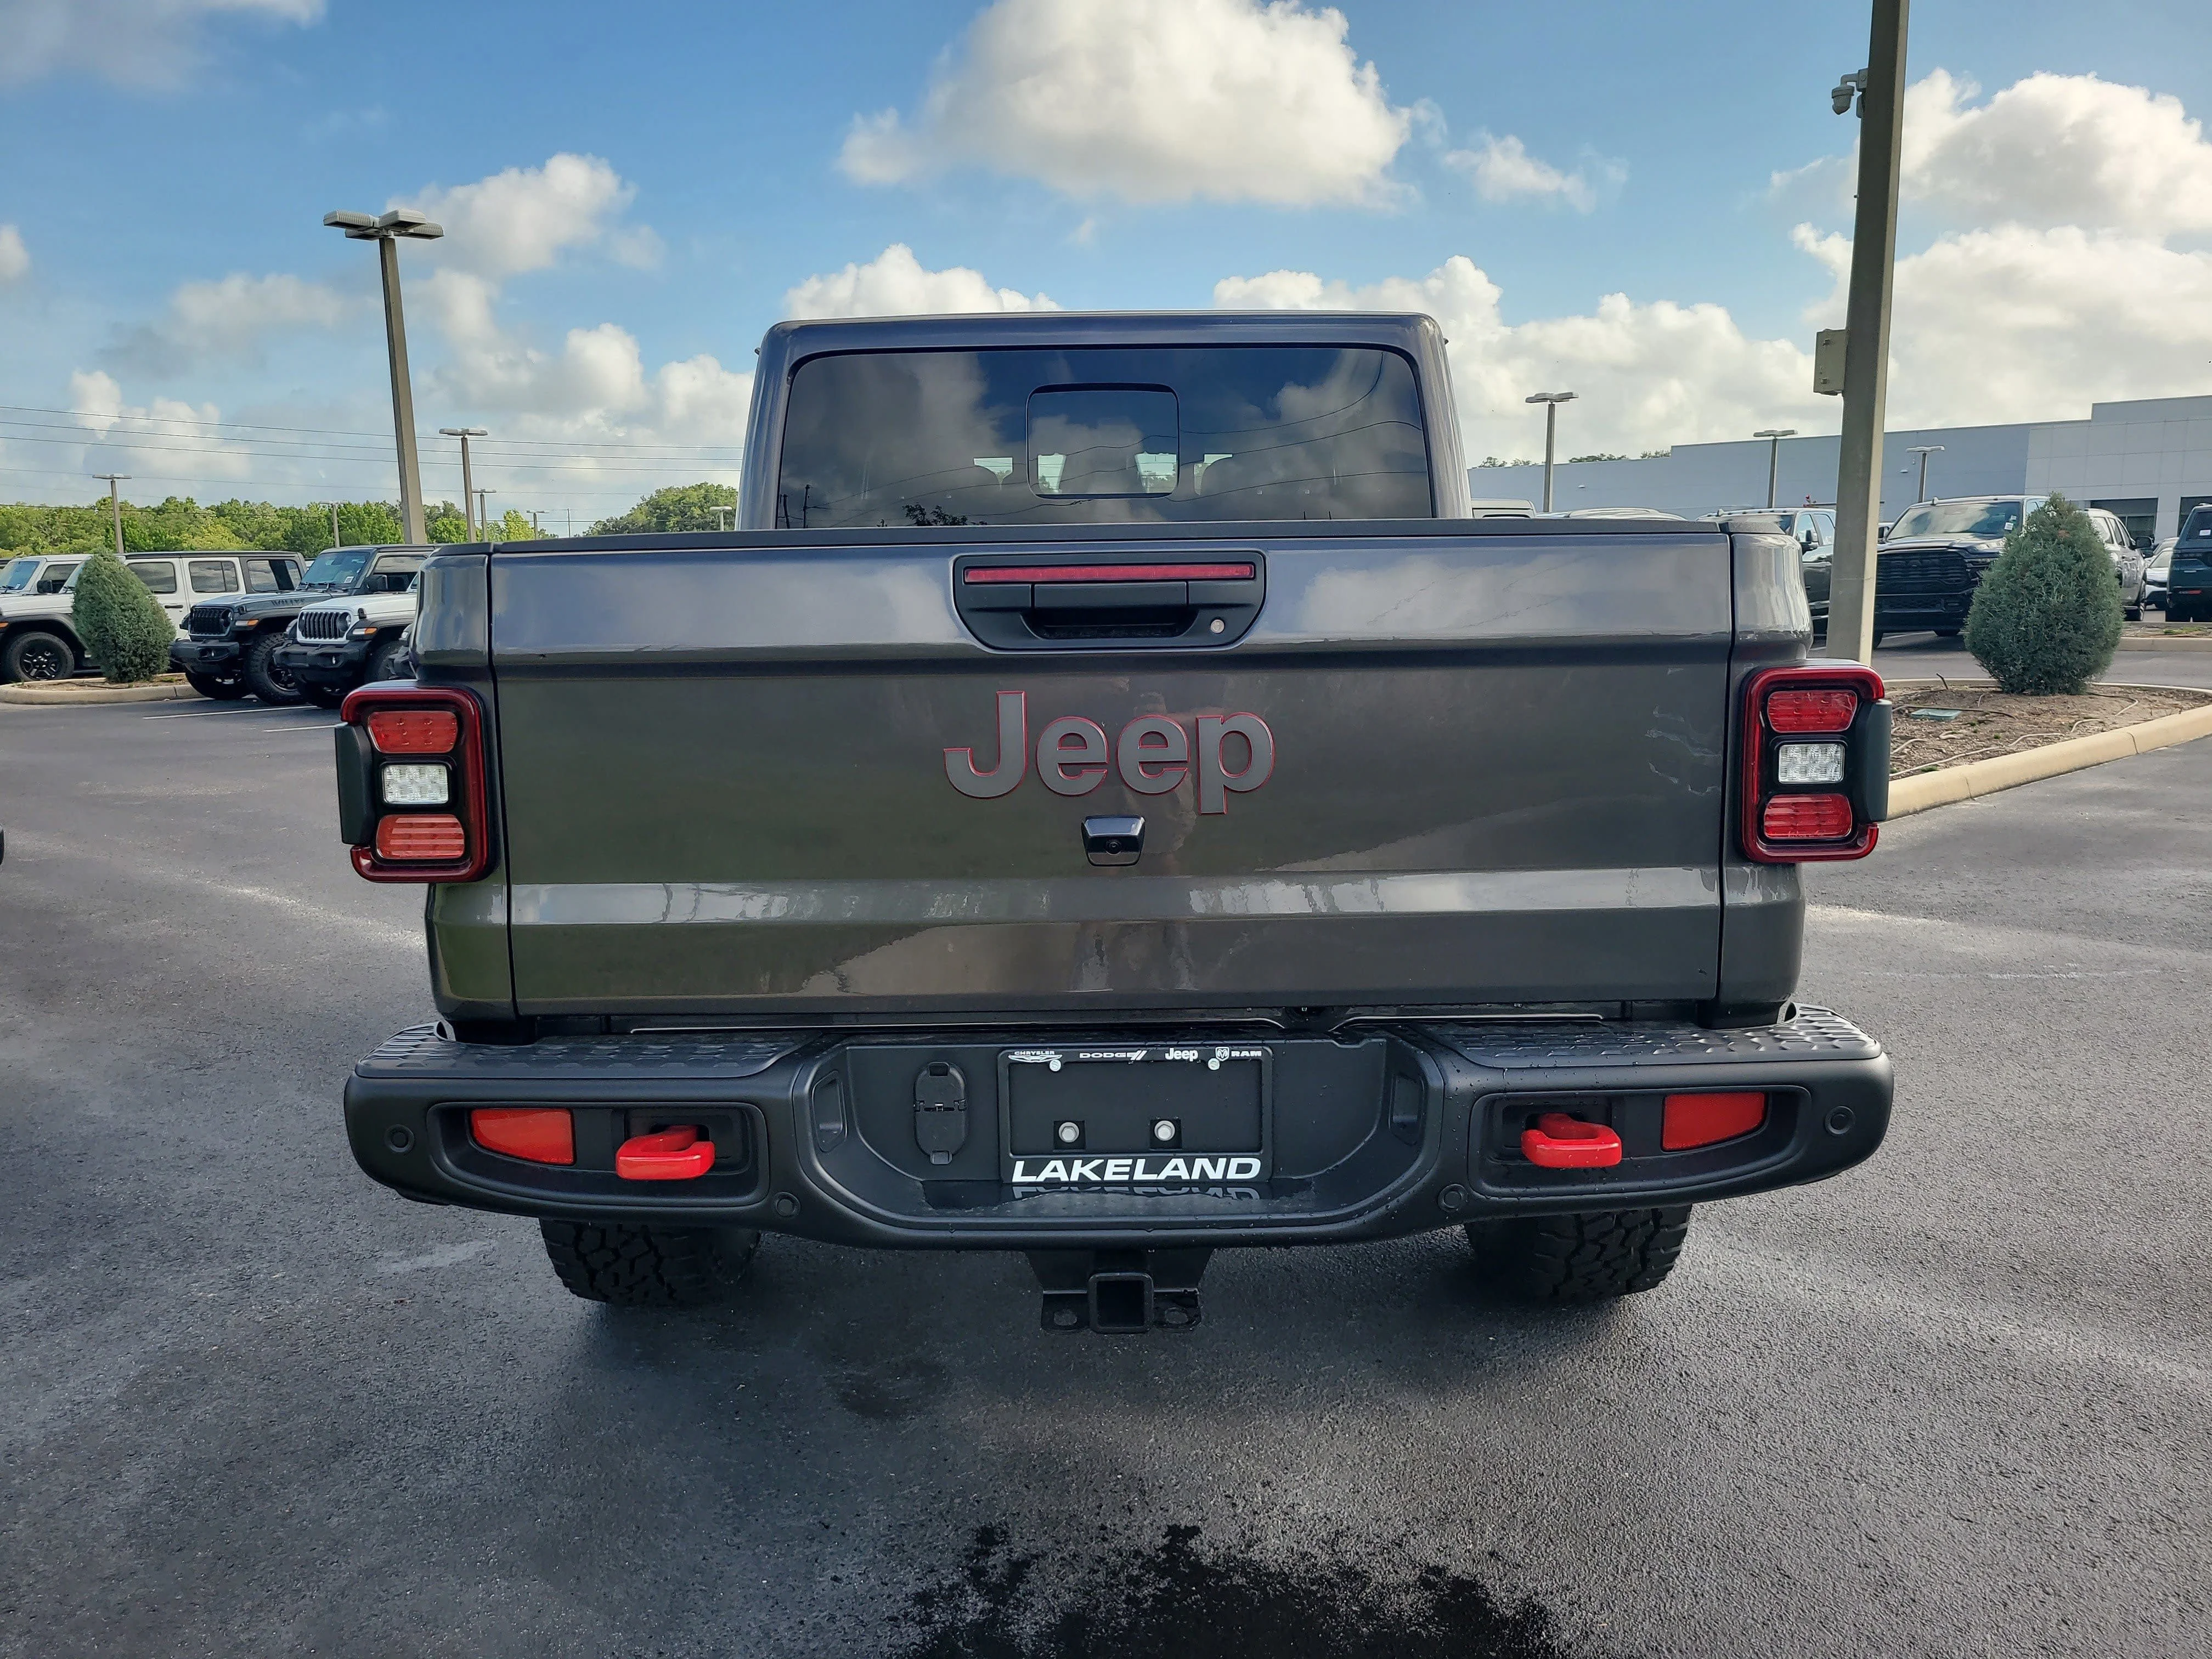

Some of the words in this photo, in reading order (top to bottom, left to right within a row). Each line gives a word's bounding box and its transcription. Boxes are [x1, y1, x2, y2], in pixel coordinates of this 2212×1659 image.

[944, 690, 1276, 815] Jeep
[1165, 1047, 1198, 1062] Jeep
[1012, 1158, 1261, 1183] LAKELAND
